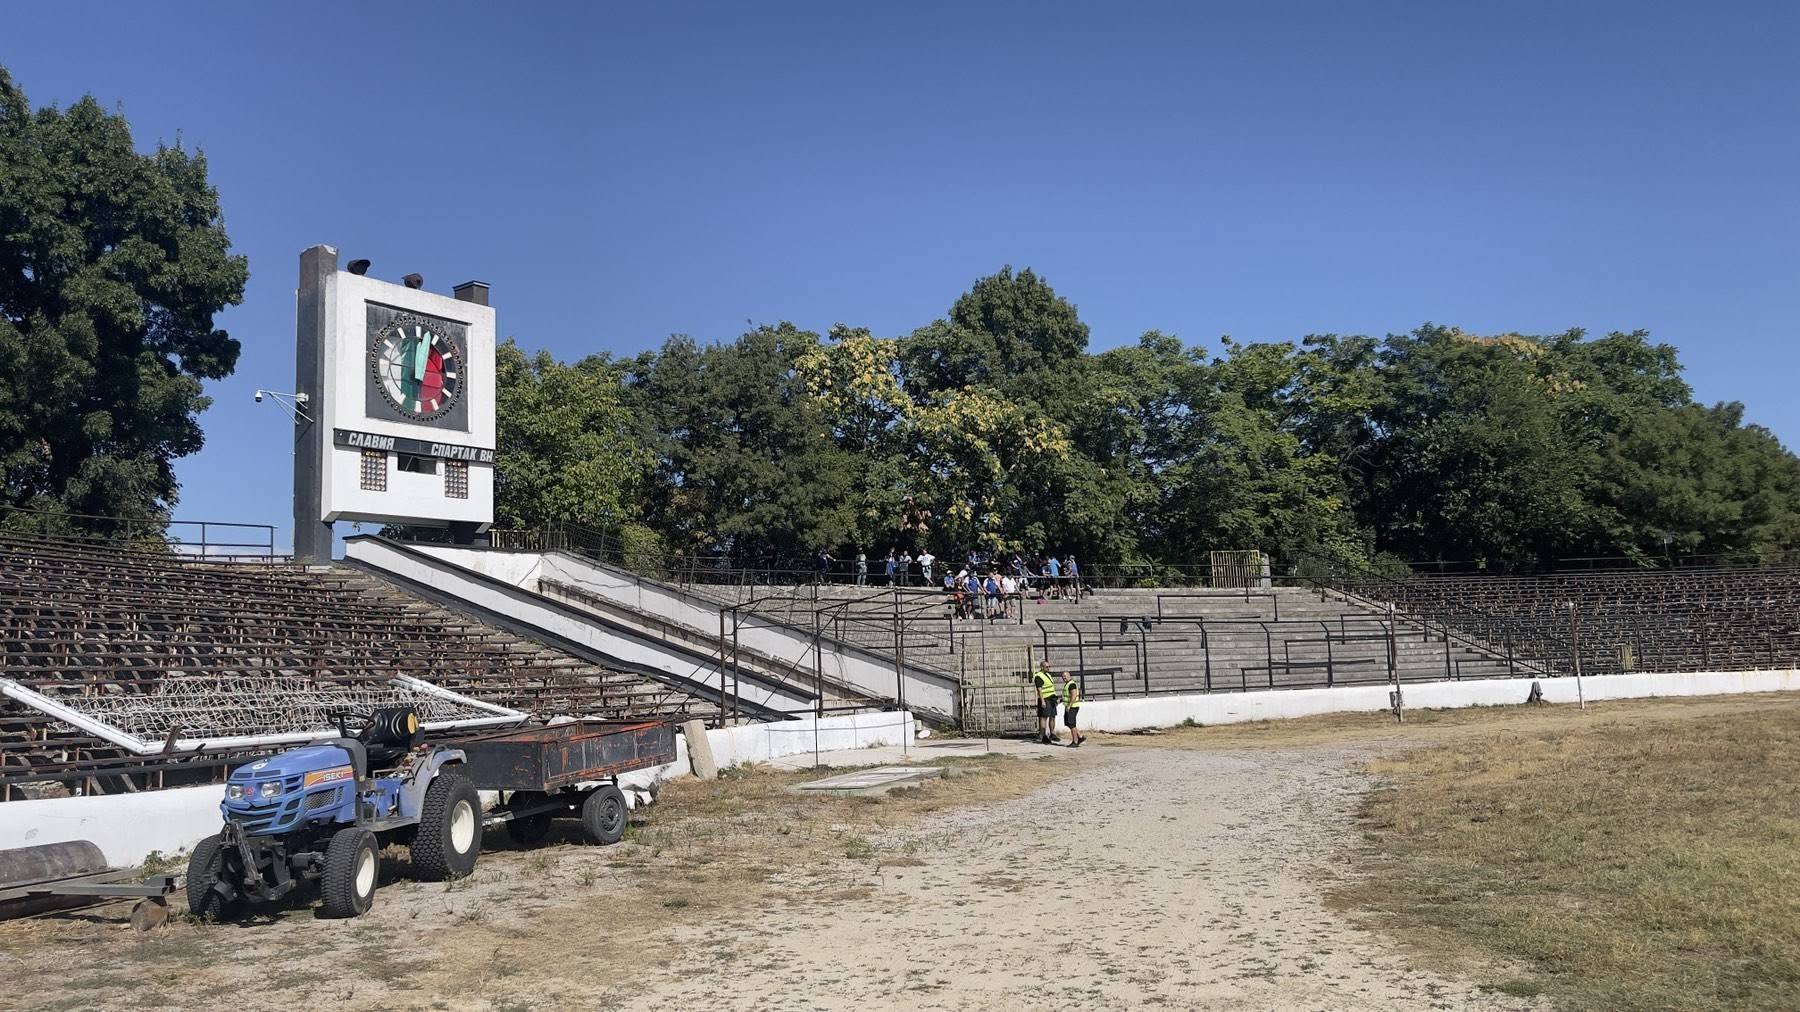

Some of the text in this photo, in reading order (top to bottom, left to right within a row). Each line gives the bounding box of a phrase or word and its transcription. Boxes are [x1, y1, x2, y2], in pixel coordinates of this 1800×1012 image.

[348, 432, 395, 450] СЛАВИЯ
[431, 443, 493, 462] СПАРТАК ВН
[322, 772, 344, 781] ISEKI
